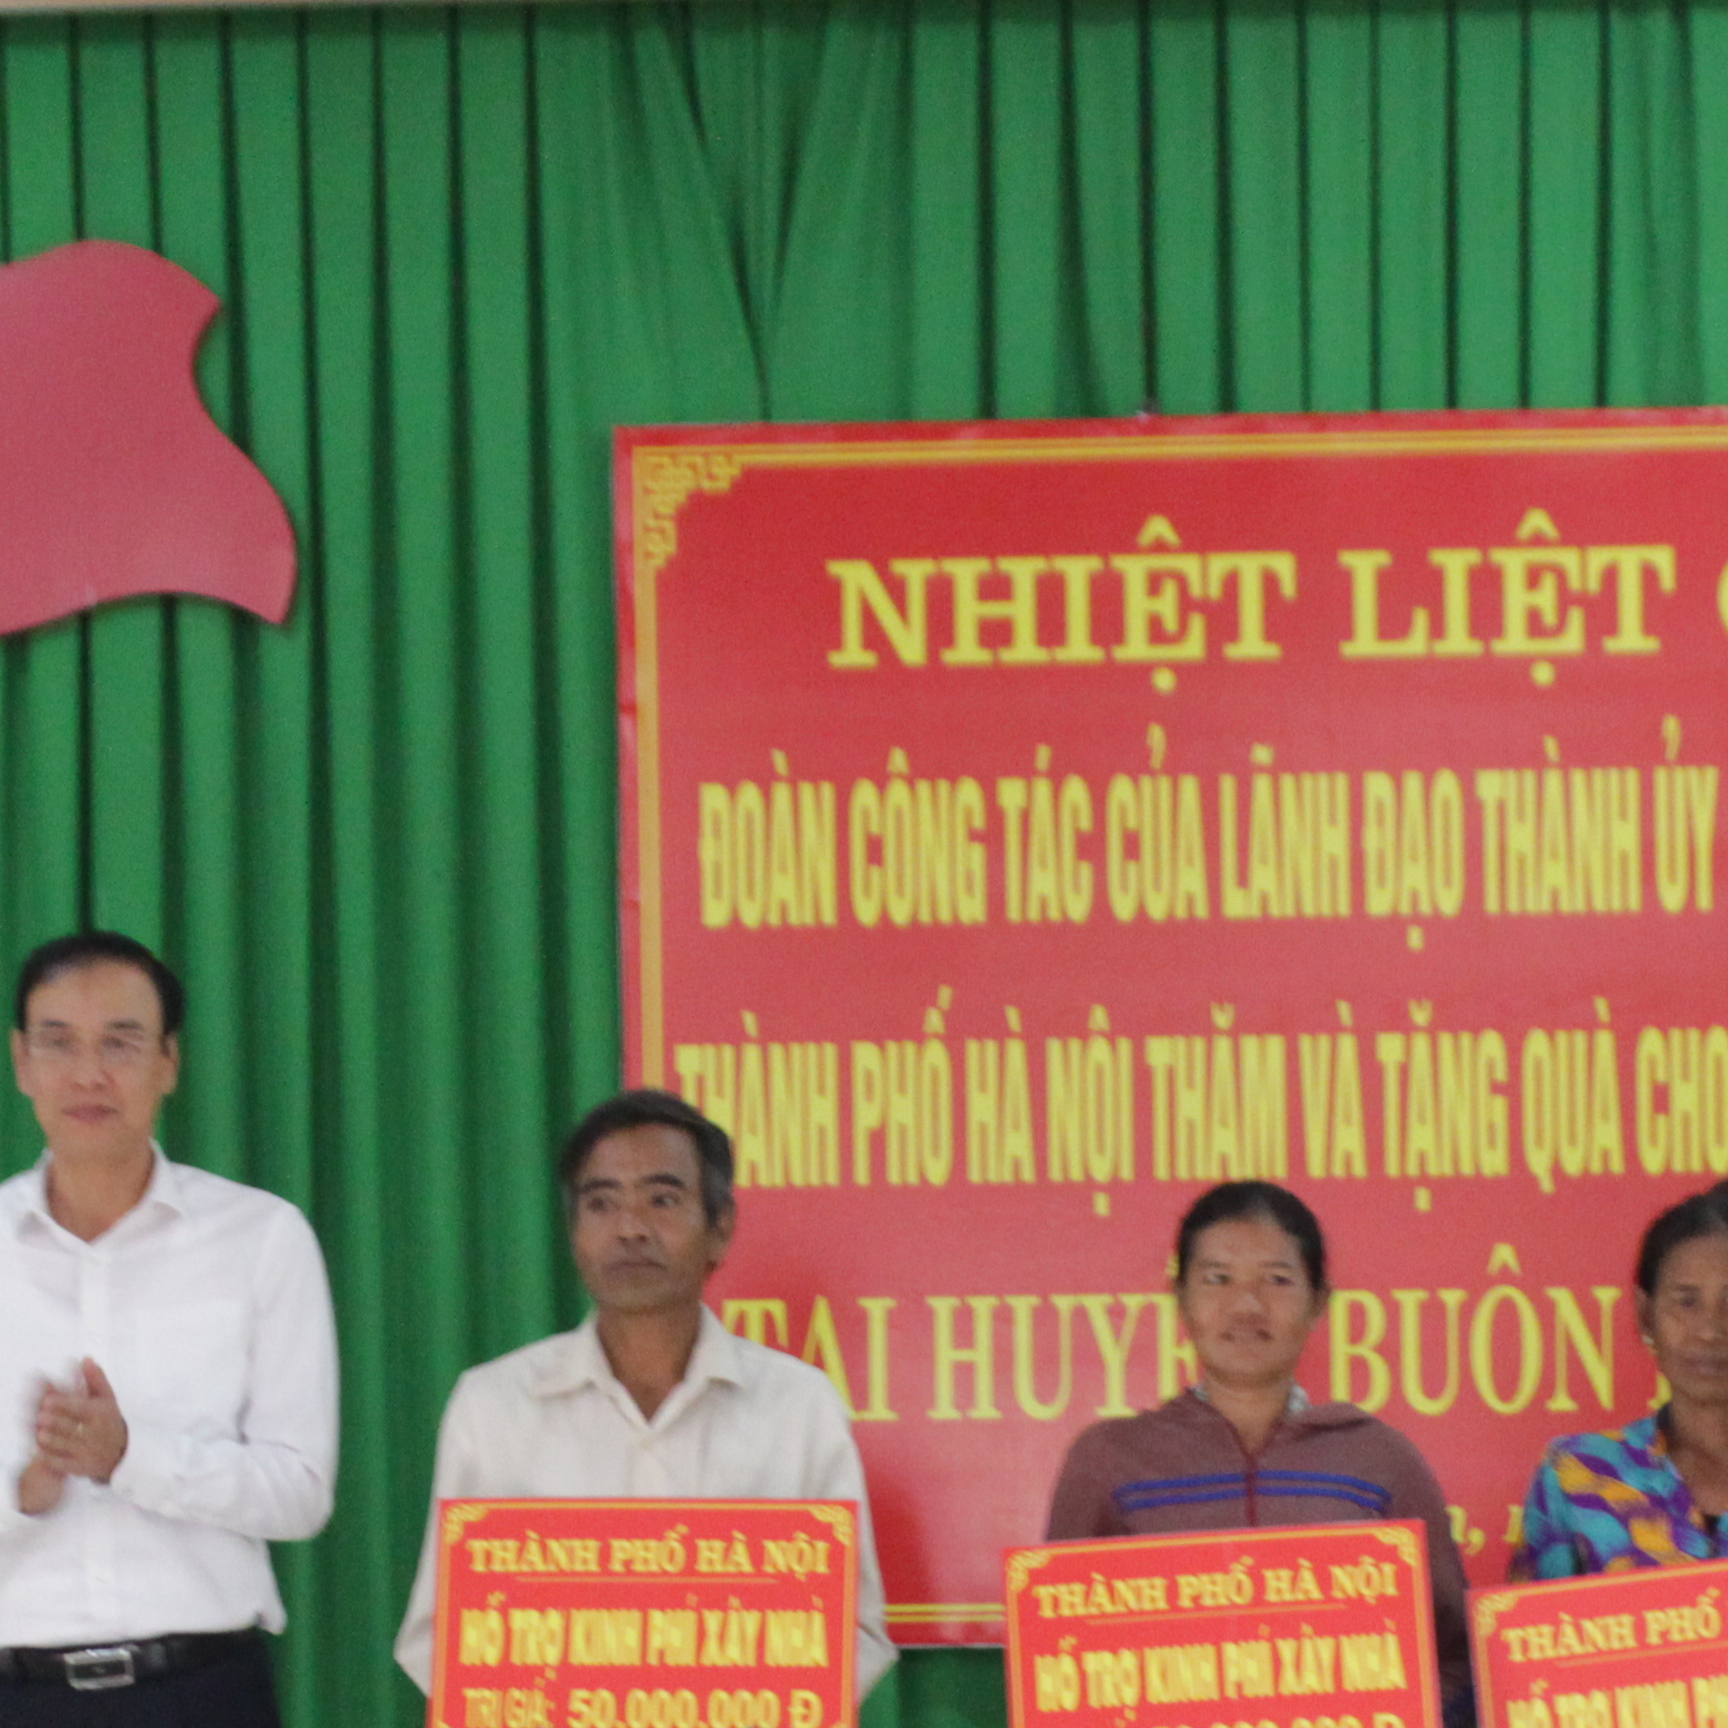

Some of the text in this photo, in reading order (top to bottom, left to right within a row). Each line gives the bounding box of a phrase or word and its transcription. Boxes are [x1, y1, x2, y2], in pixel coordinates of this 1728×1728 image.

[828, 516, 1296, 693] NHIỆT
[1339, 509, 1676, 687] LIỆT
[698, 750, 837, 929] ĐOÀN
[850, 748, 987, 928] CÔNG
[997, 745, 1094, 924] TÁC
[1106, 724, 1209, 923] CỦA
[1219, 741, 1352, 920] LÃNH
[1361, 768, 1465, 952] ĐẠO
[1474, 736, 1642, 916] THÀNH
[1653, 715, 1719, 915] ỦY
[674, 1011, 840, 1188] THÀNH
[851, 986, 953, 1187] PHỐ
[965, 1006, 1036, 1184] HÀ
[1046, 1004, 1134, 1217] NỘI
[1145, 1004, 1288, 1181] THĂM
[1298, 1000, 1367, 1179] VÀ
[1375, 1000, 1509, 1212] TẶNG
[1522, 997, 1625, 1193] QUÀ
[1329, 1243, 1621, 1416] BUÔN
[465, 1525, 829, 1580] THÀNH PHỐ HÀ NỘI
[1033, 1555, 1399, 1618] THÀNH PHỐ HÀ NỘI
[700, 1597, 762, 1666] XÂY
[765, 1598, 828, 1666] NHÀ
[1276, 1624, 1336, 1695] XÂY
[1339, 1620, 1407, 1692] NHÀ
[1501, 1612, 1637, 1662] THÀNH
[1643, 1588, 1721, 1645] PHỐ
